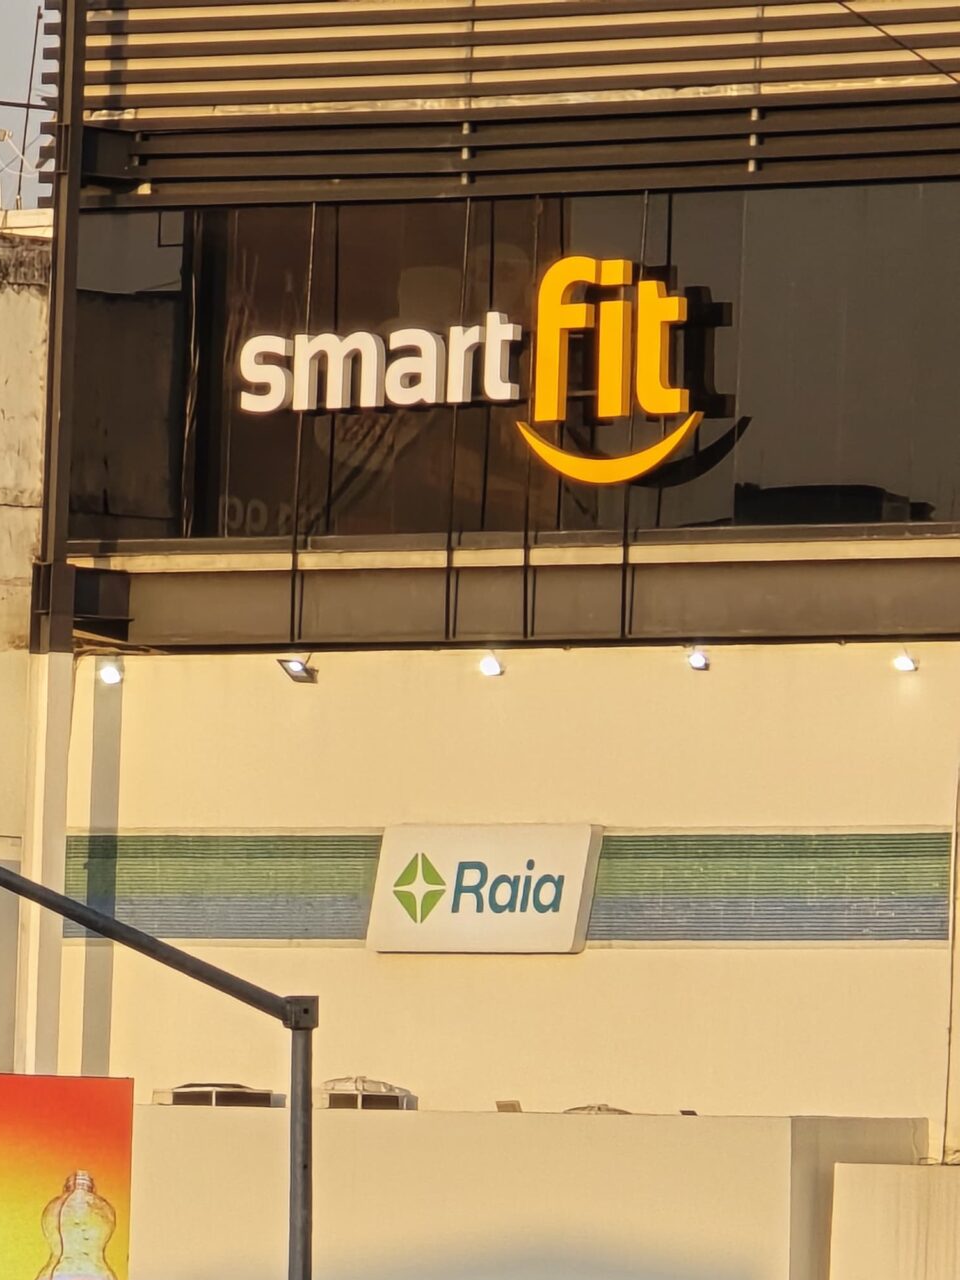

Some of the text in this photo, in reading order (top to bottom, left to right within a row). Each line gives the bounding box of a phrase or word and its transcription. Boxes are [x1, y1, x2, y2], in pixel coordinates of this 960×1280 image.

[239, 255, 690, 422] smart fit
[451, 859, 565, 913] Raia
